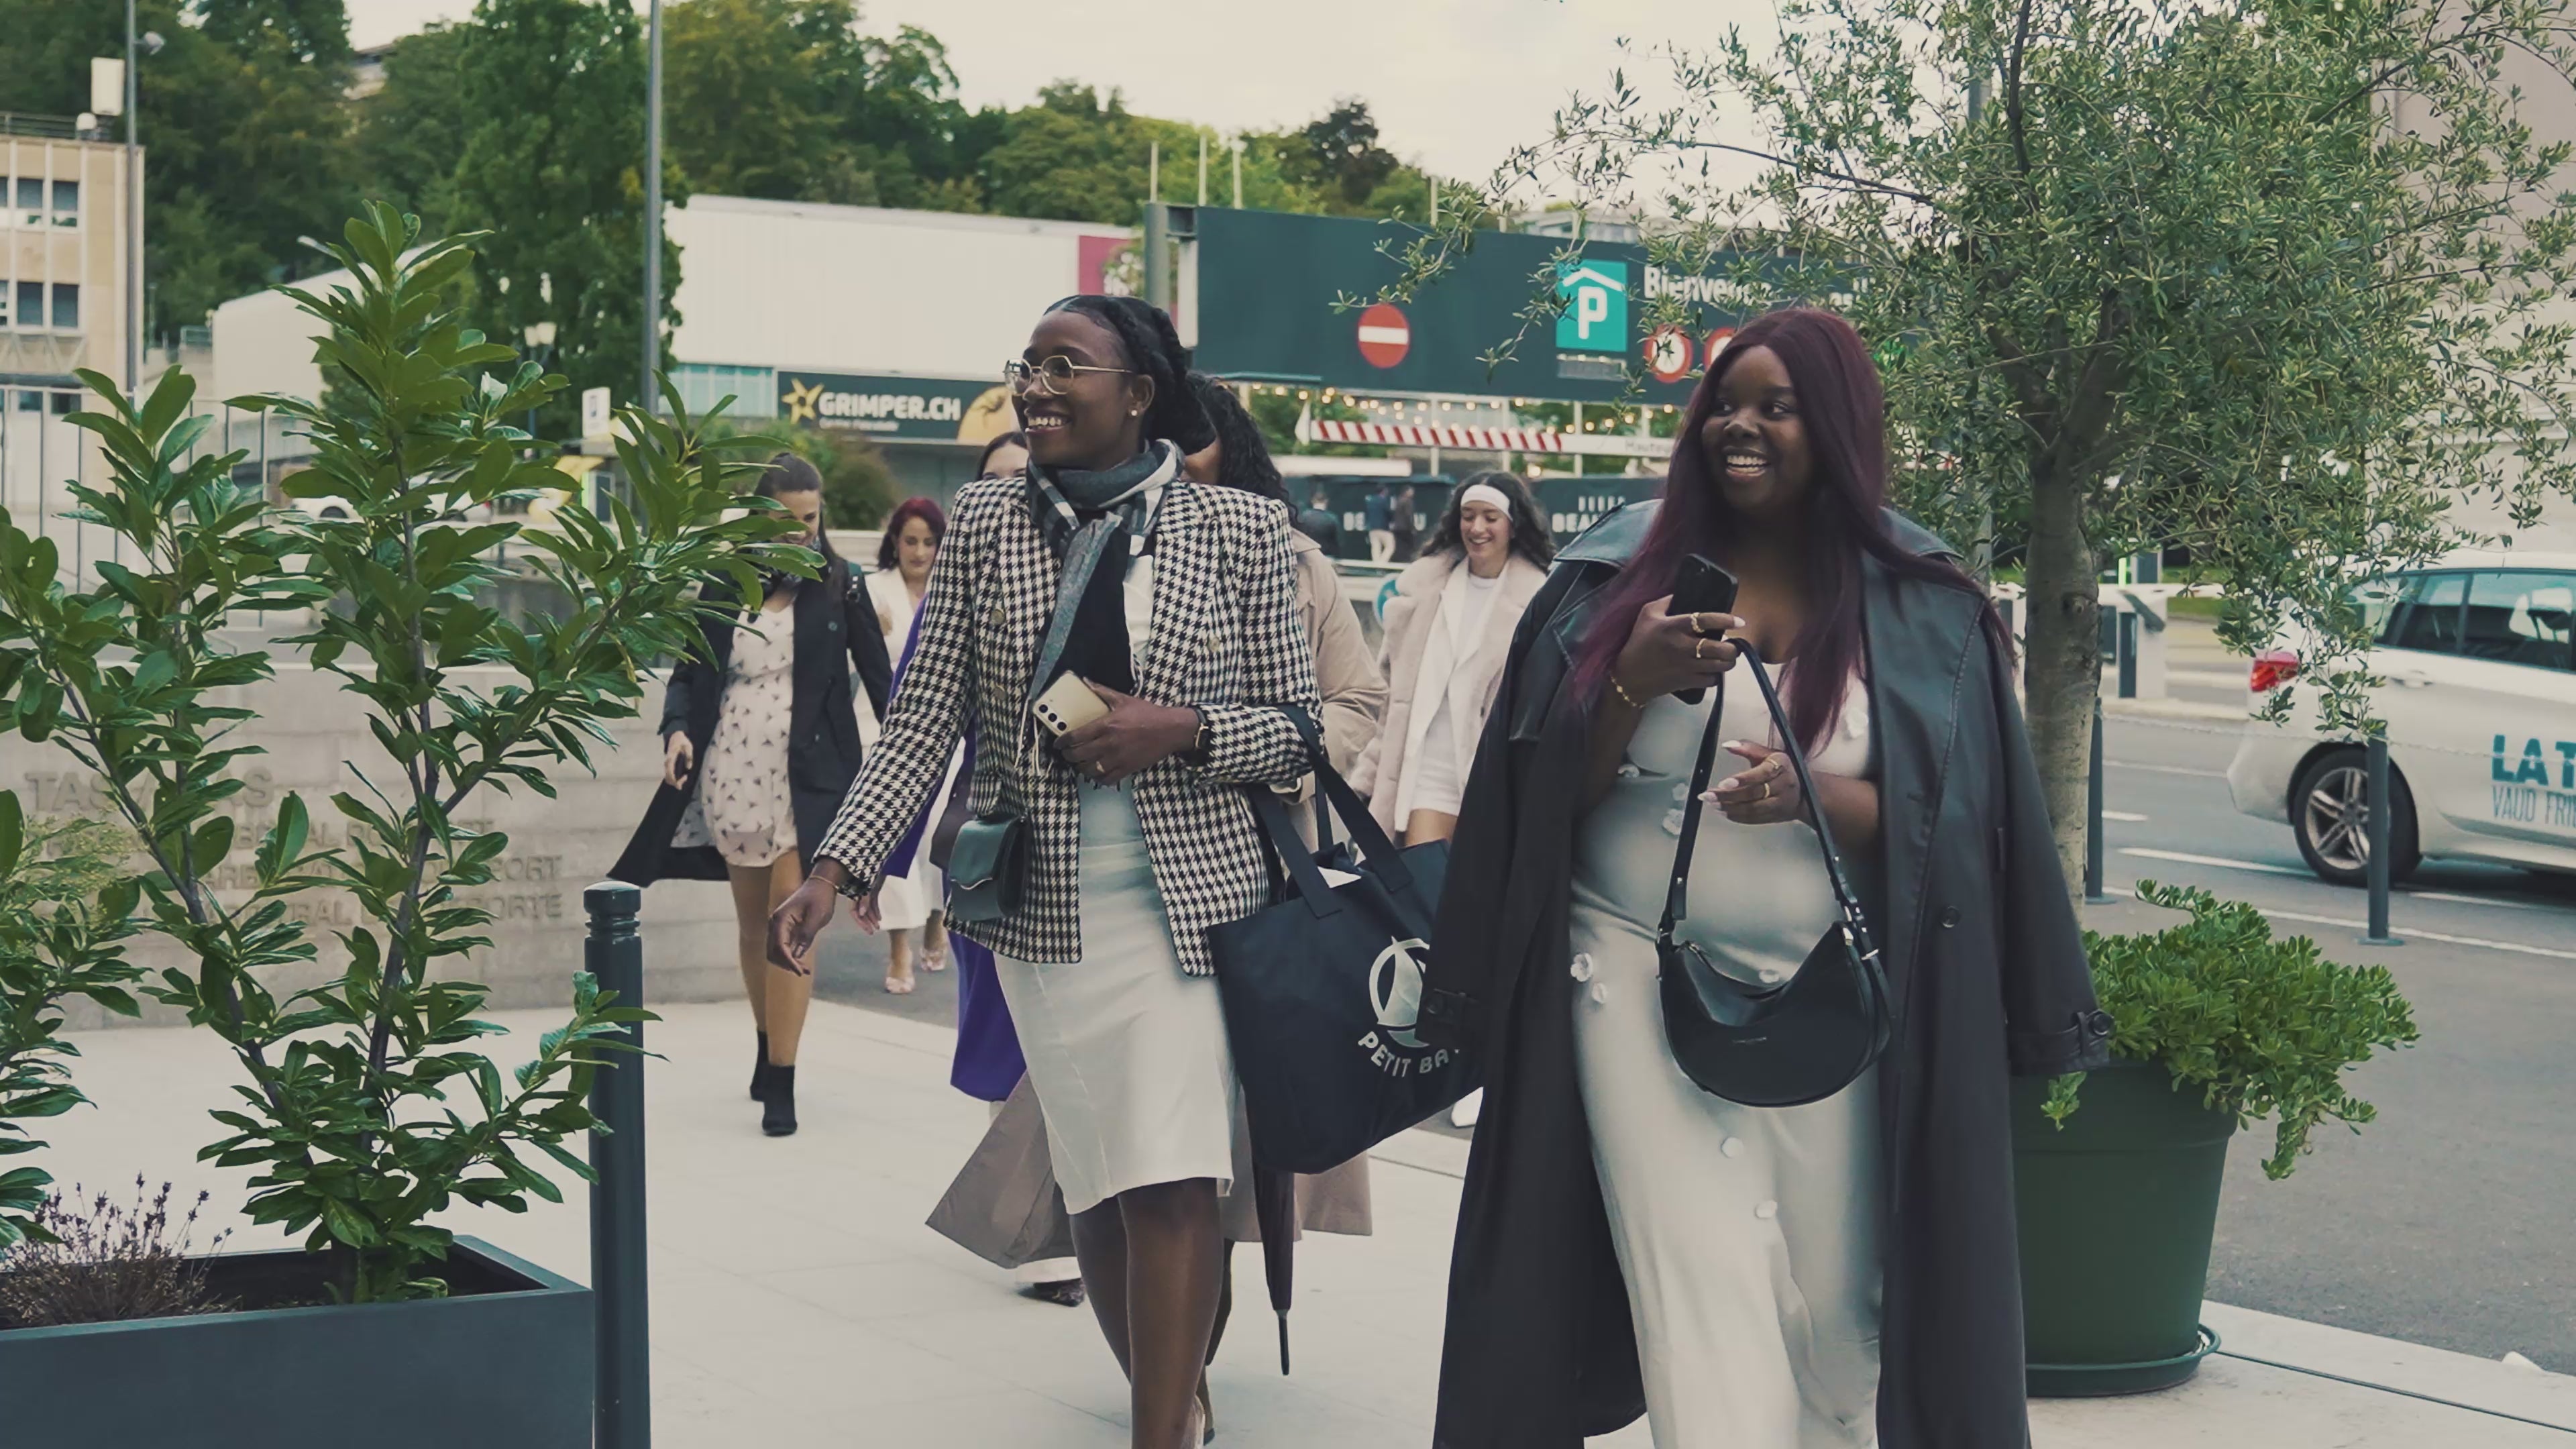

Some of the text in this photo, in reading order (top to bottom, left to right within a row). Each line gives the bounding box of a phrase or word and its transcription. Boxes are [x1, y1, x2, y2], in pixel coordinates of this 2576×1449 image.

[1578, 286, 1608, 339] P
[818, 391, 961, 421] GRIMPER.CH
[2492, 735, 2549, 786] LA
[2491, 784, 2576, 828] VAUD FRI
[1357, 1030, 1460, 1078] PETIT BA
